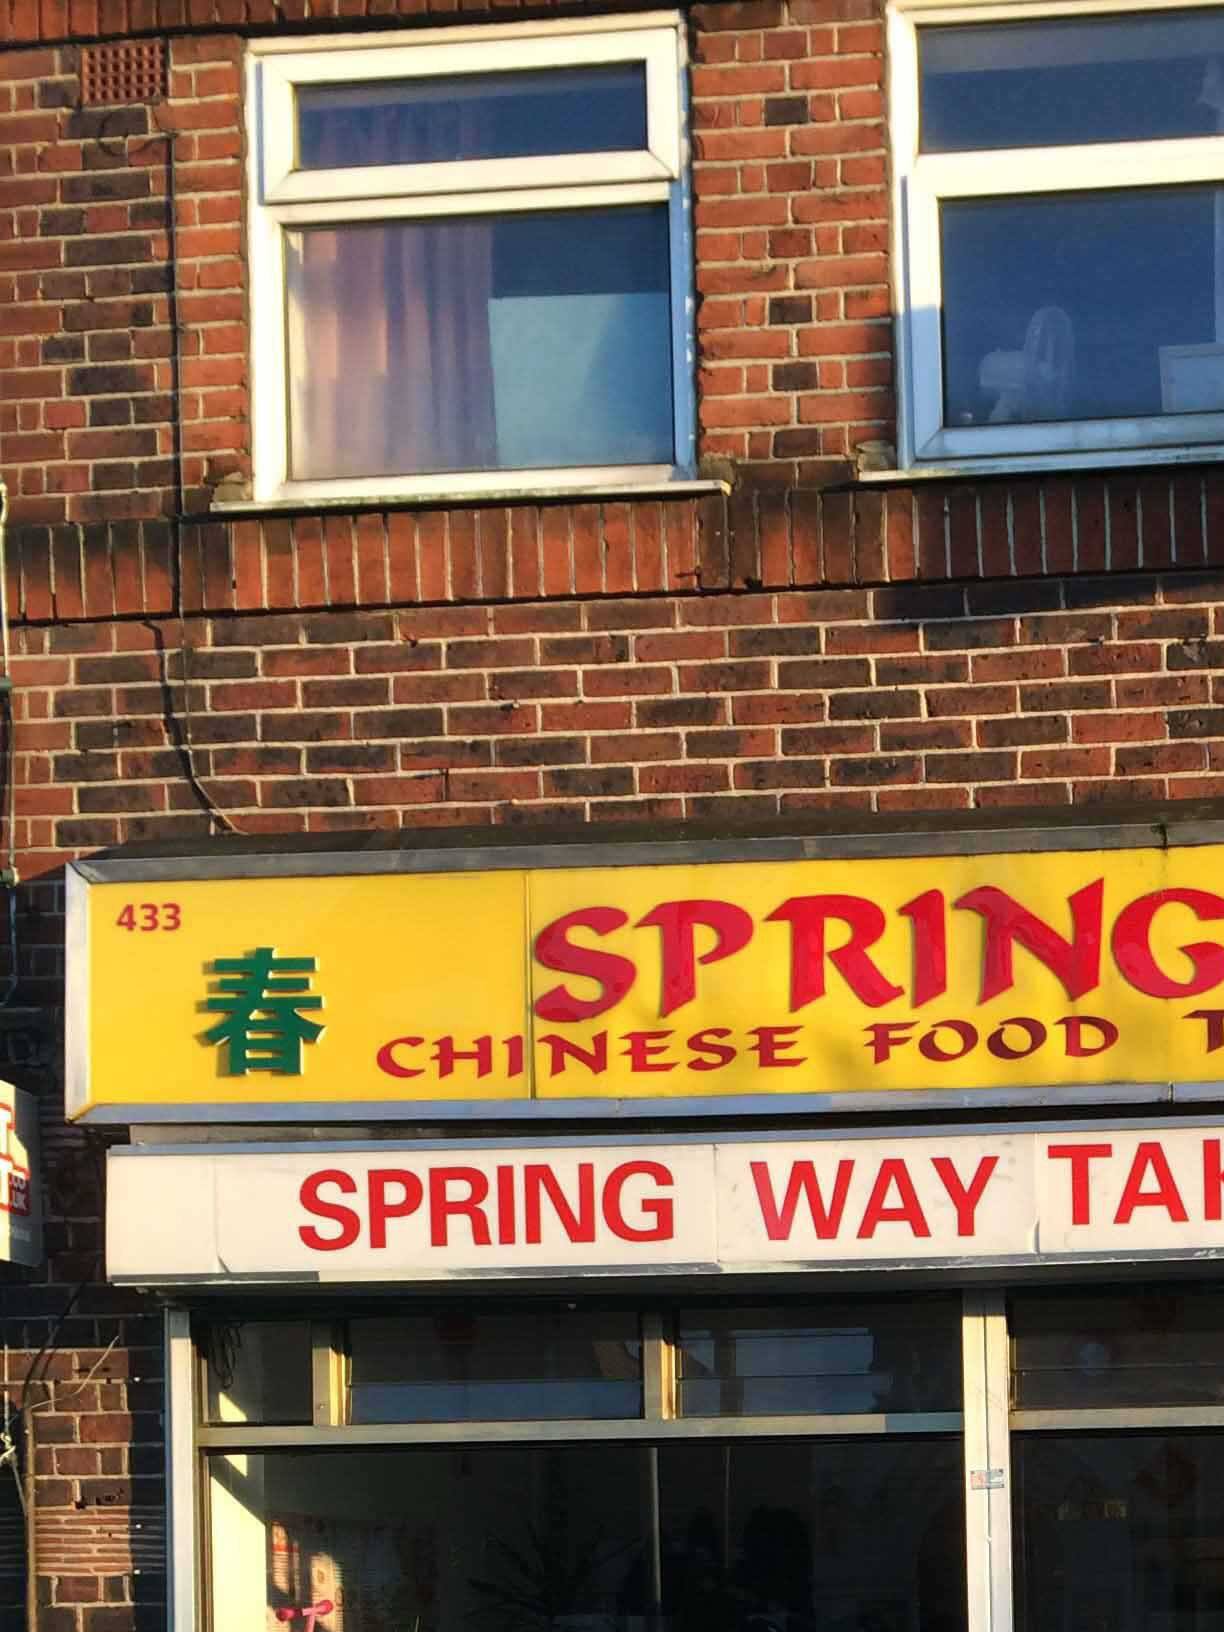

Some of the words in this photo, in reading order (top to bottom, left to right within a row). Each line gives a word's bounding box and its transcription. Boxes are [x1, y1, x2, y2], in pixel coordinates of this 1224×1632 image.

[115, 902, 182, 932] 433
[206, 948, 325, 1077] 春
[376, 1022, 806, 1079] CHINESE
[863, 1013, 1120, 1065] FOOD
[298, 1160, 674, 1252] SPRING
[750, 1155, 999, 1242] WAY
